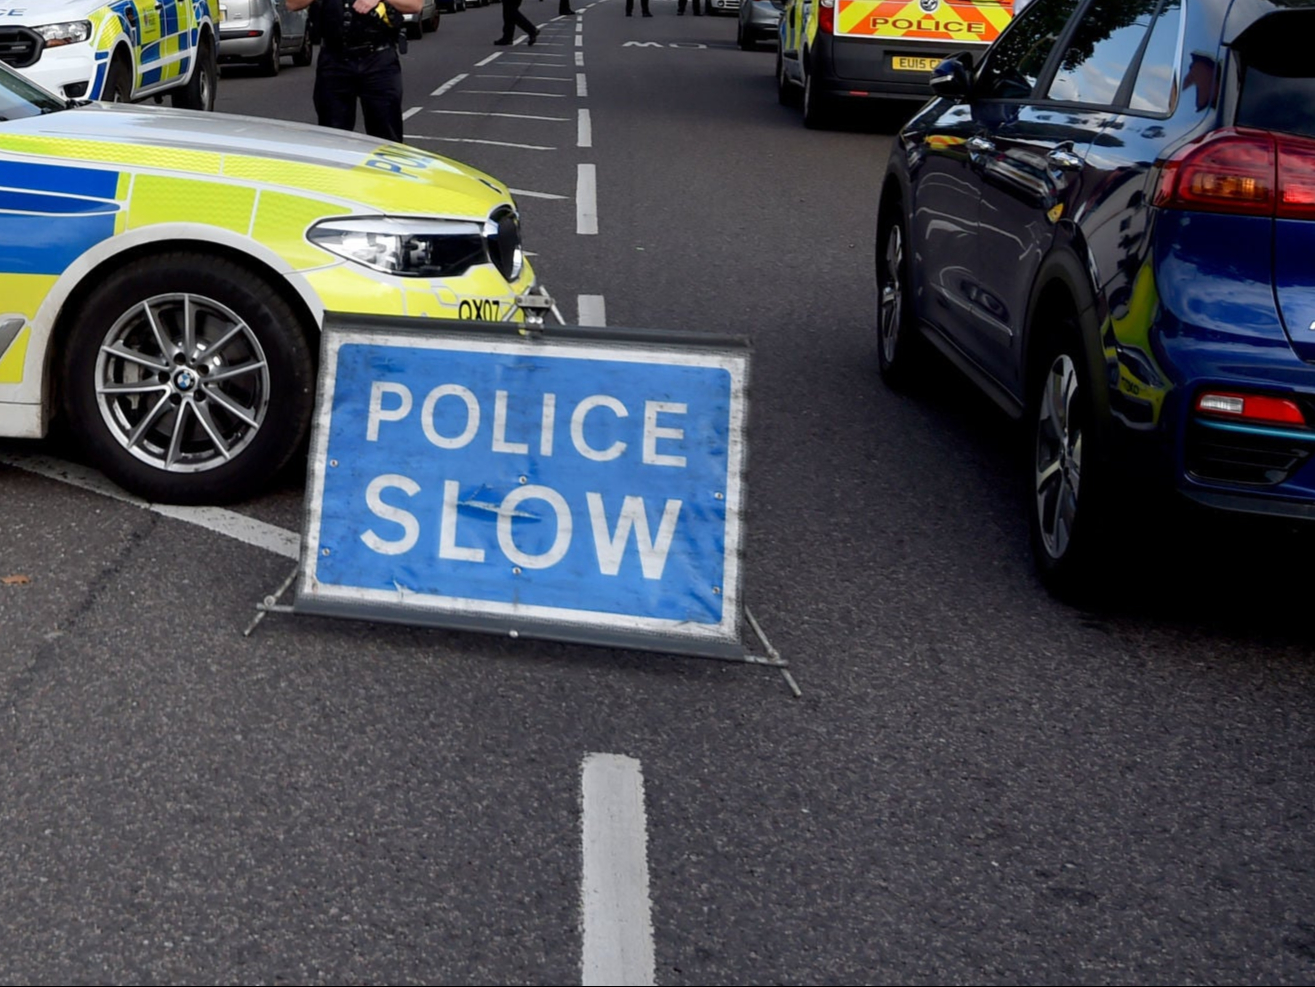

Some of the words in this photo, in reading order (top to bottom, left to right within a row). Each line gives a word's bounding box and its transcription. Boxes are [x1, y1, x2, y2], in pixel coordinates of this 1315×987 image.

[871, 18, 984, 34] POLICE
[899, 58, 926, 69] EU15
[459, 299, 500, 322] QX07
[365, 380, 688, 467] POLICE
[359, 473, 683, 580] SLOW
